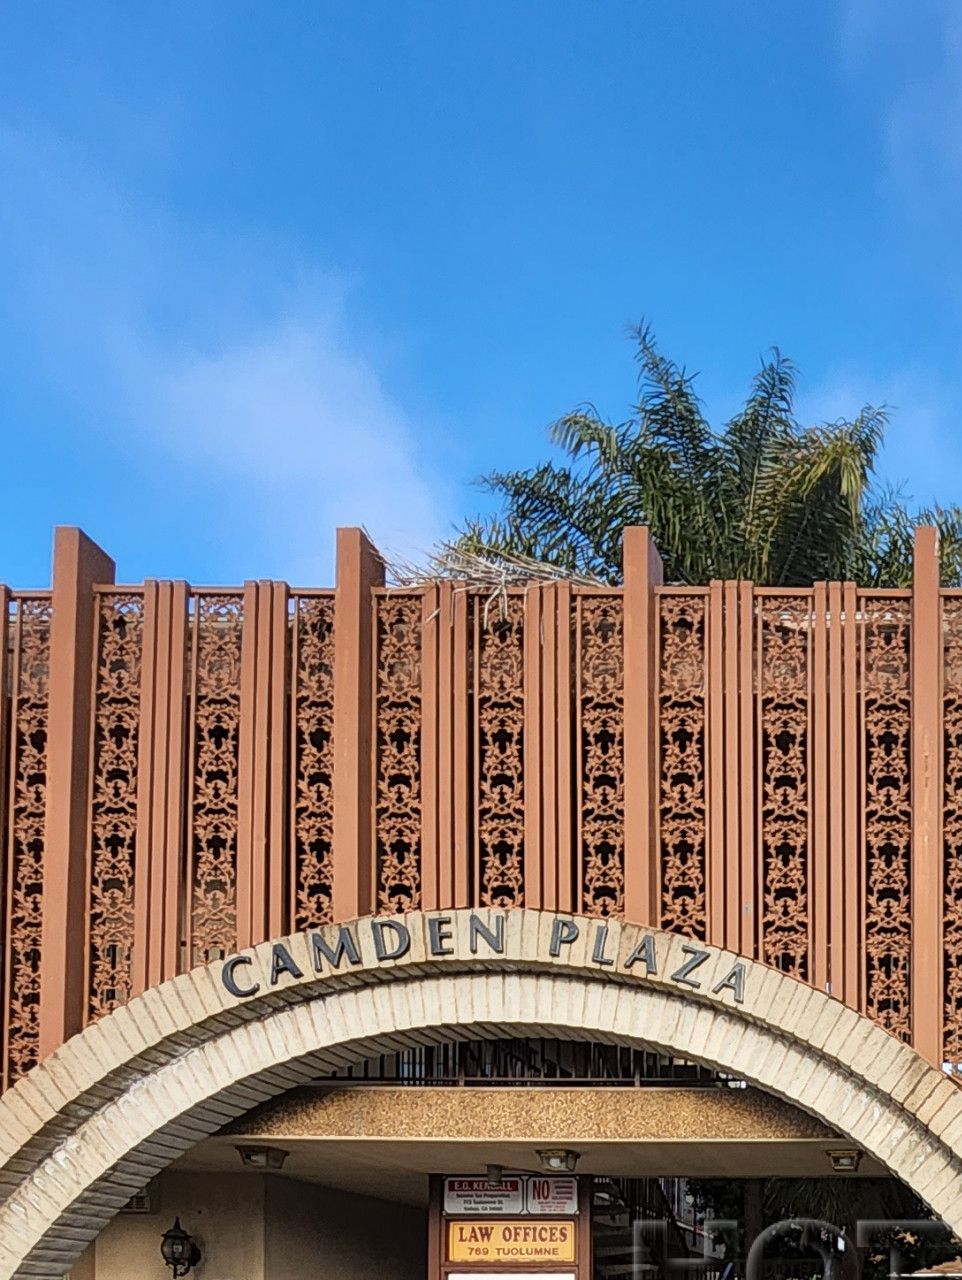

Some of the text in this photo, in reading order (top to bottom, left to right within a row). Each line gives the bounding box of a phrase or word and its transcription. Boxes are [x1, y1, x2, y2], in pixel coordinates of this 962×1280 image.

[221, 914, 746, 1004] CAMDEN PLAZA
[532, 1180, 550, 1200] NO
[458, 1226, 567, 1242] LAW OFFICES
[467, 1247, 559, 1255] 769 TUOLUMNE
